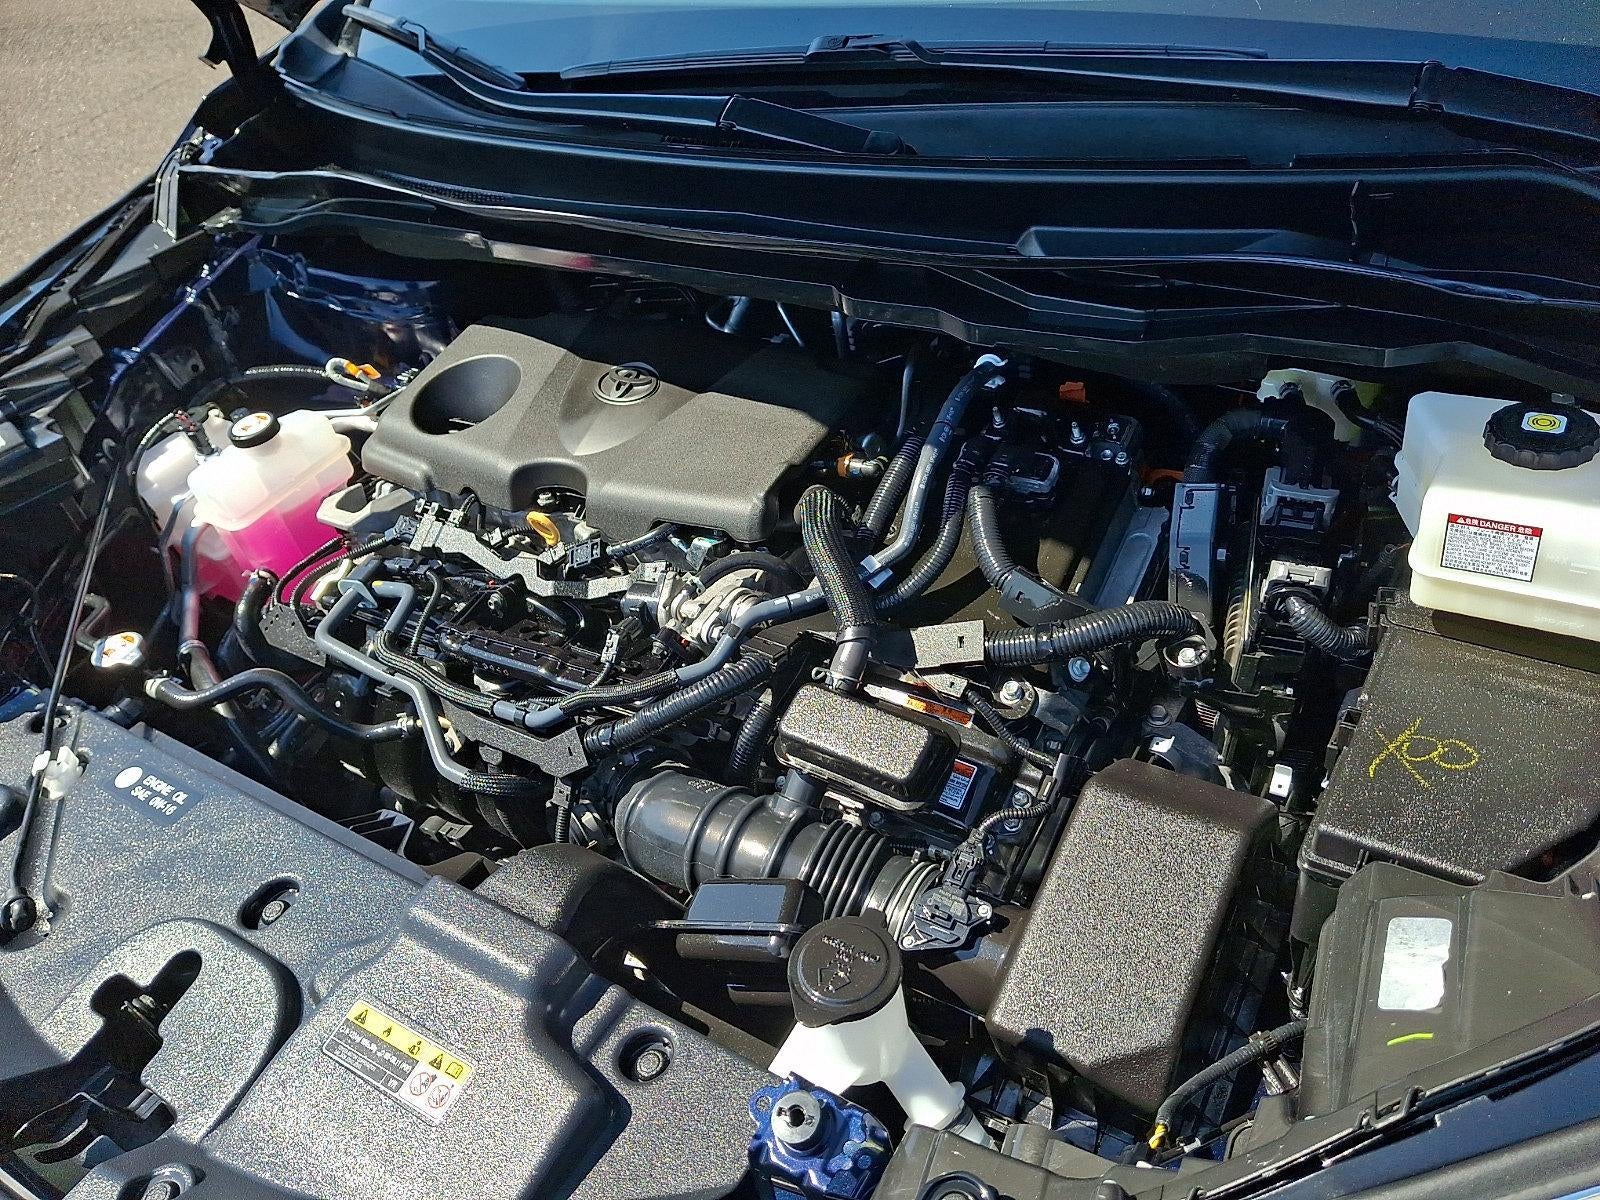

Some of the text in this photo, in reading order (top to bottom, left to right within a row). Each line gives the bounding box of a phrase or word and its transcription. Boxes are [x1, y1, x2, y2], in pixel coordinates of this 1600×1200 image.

[1480, 520, 1517, 532] DANGER
[130, 785, 178, 816] SAE 0W-16
[142, 774, 189, 806] ENGINE OIL
